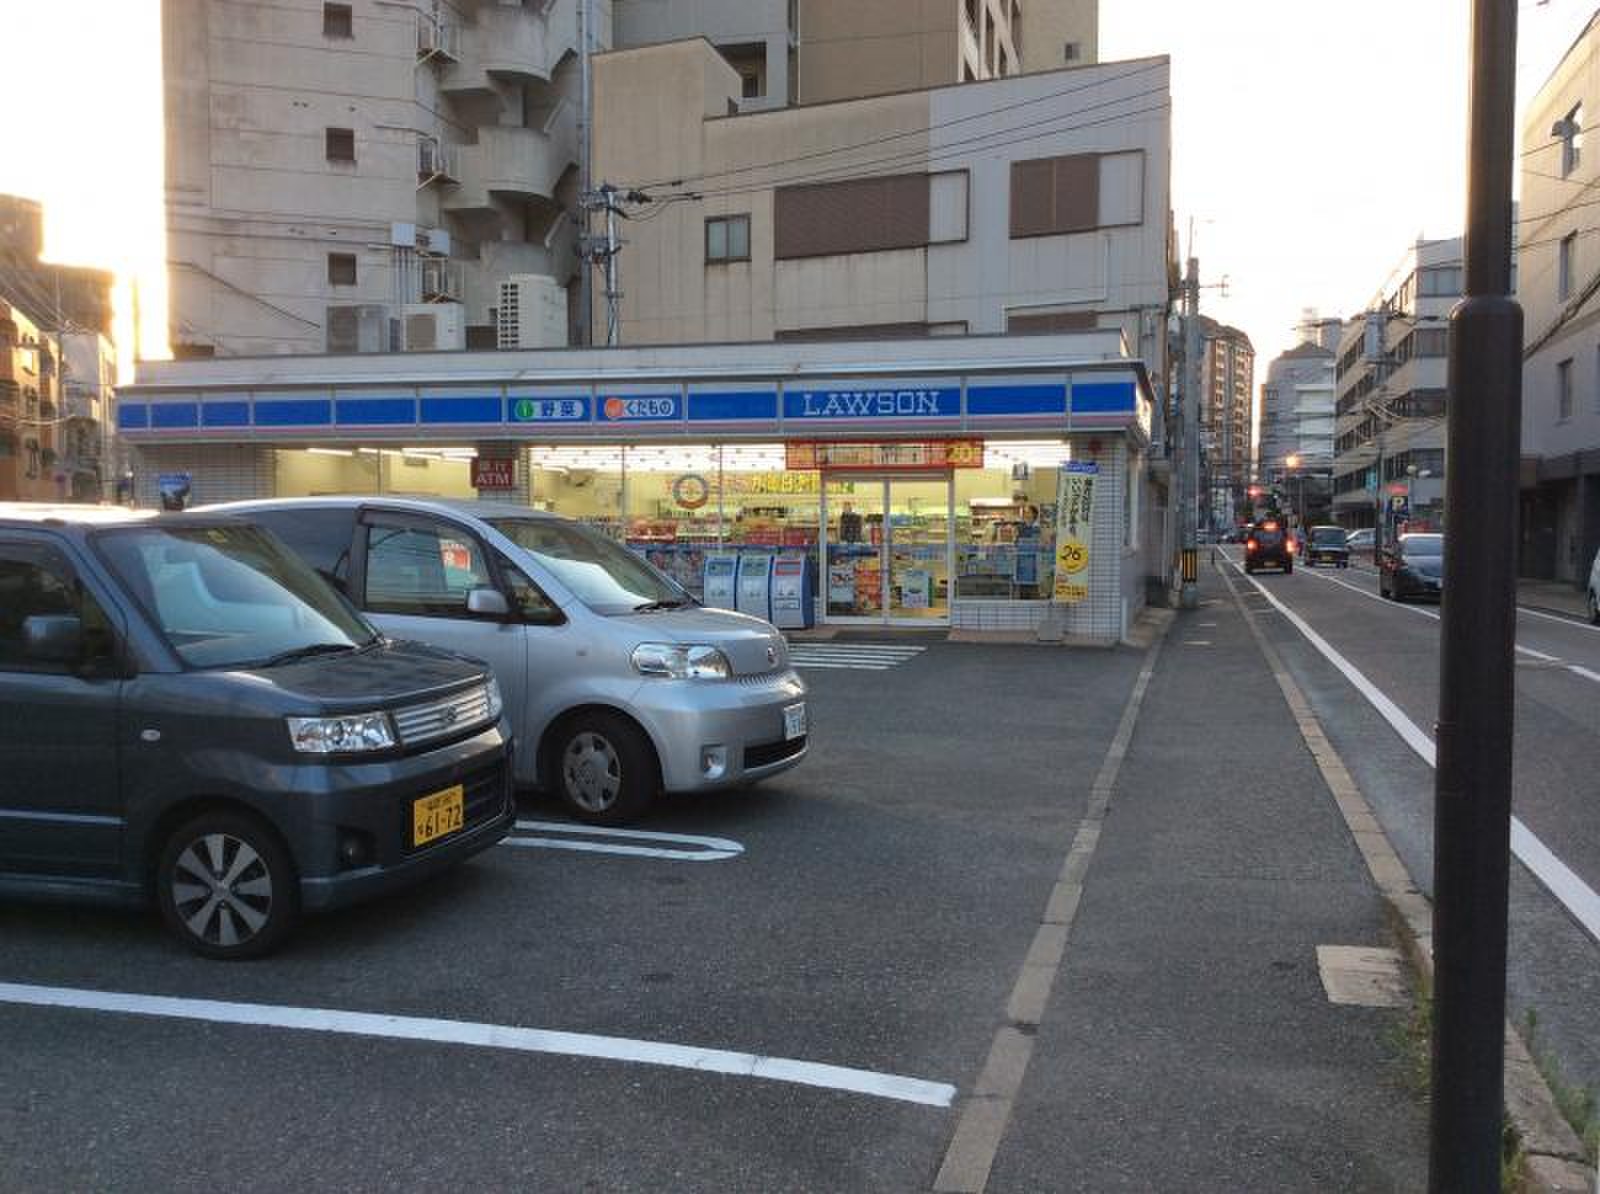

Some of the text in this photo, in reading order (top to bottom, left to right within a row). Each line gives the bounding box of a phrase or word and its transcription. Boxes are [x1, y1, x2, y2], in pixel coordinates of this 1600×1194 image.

[541, 400, 576, 417] 野菜
[803, 391, 939, 416] LAWSON
[475, 473, 510, 485] ATM
[425, 804, 461, 838] 61-72
